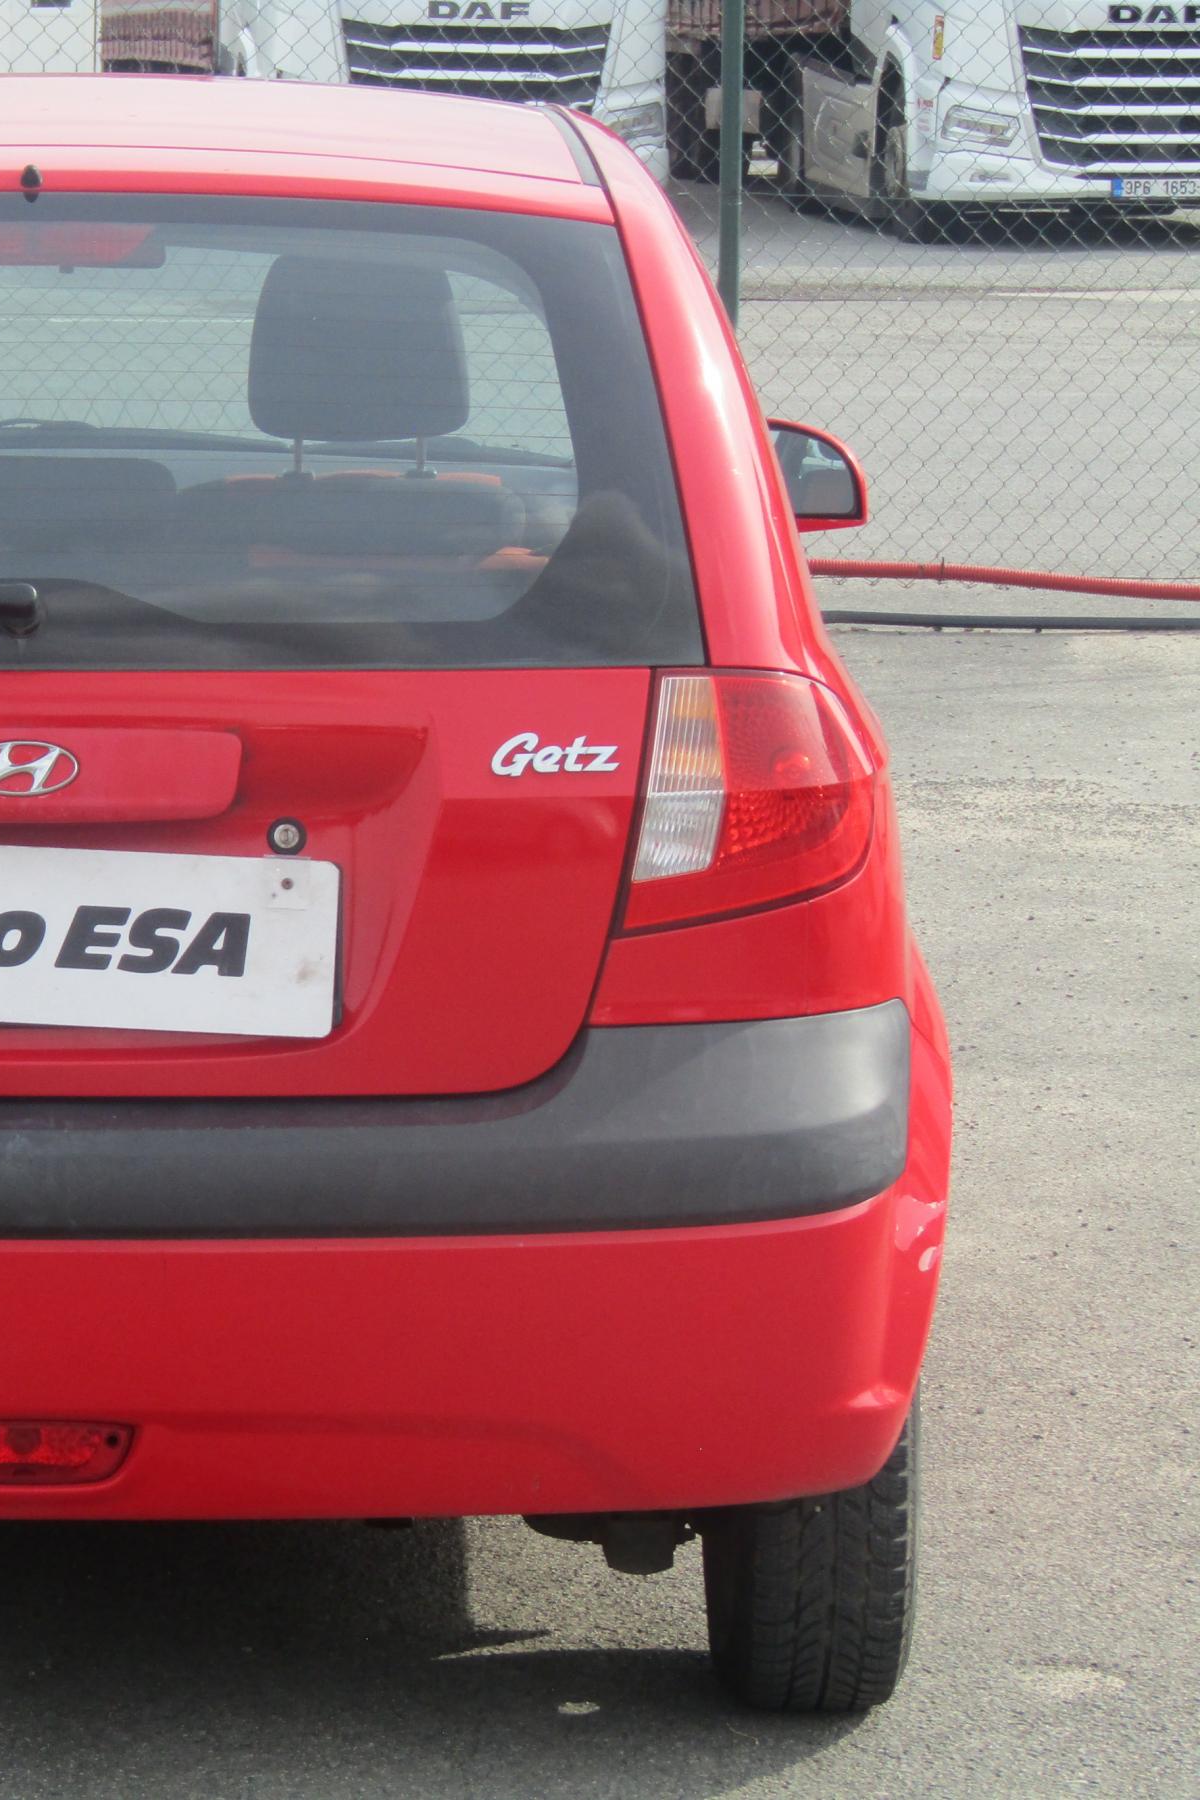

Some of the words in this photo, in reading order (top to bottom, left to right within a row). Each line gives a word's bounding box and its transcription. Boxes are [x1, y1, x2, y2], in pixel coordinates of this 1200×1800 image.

[428, 1, 530, 20] DAF
[491, 732, 620, 777] Getz
[54, 904, 251, 977] ESA
